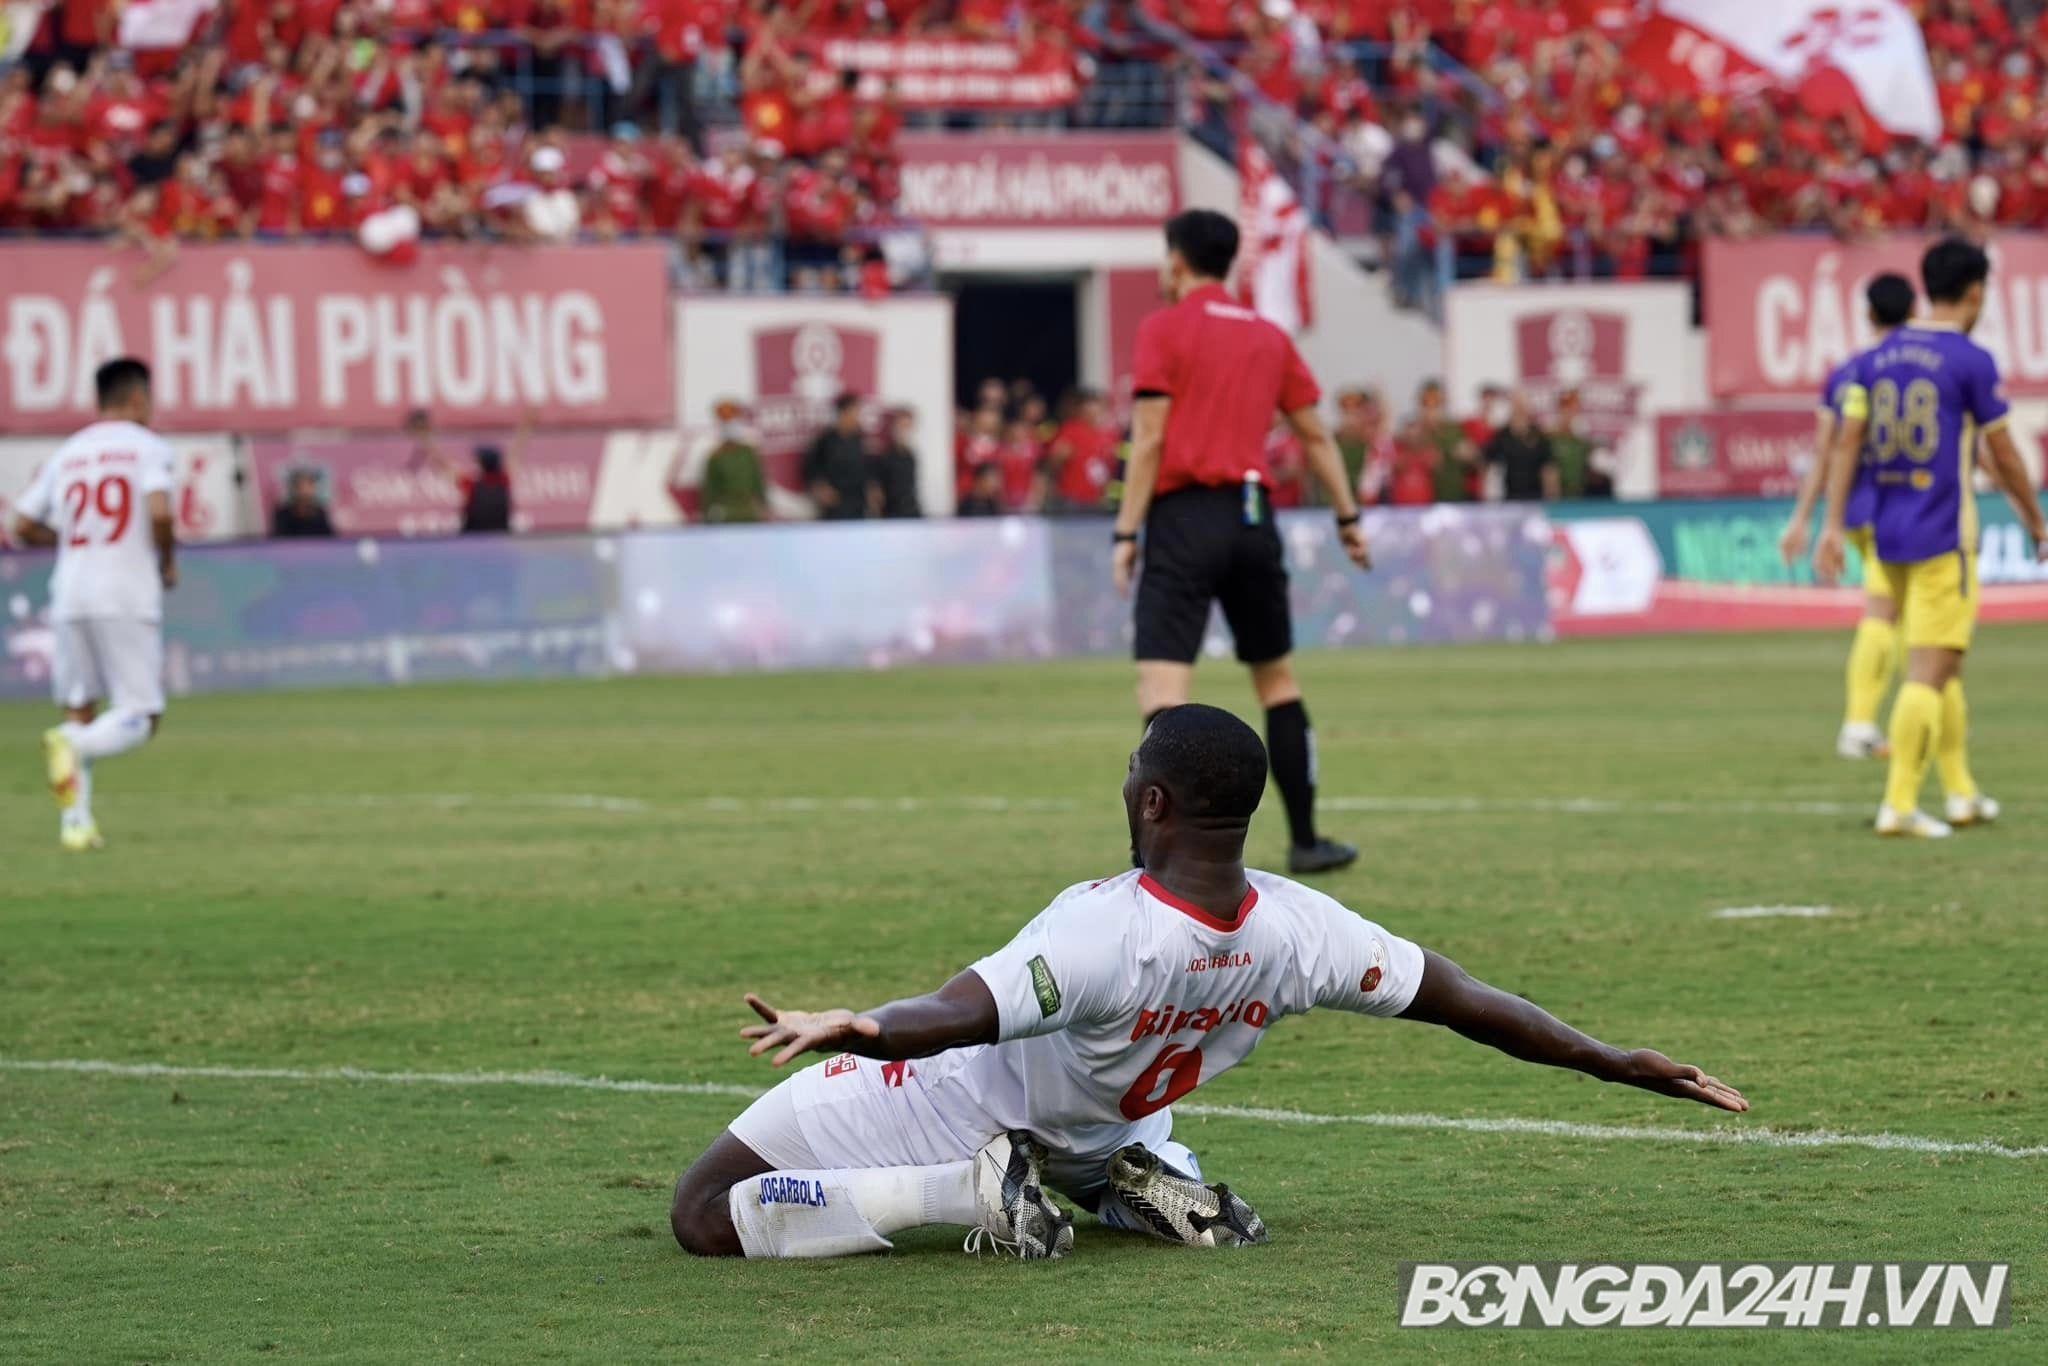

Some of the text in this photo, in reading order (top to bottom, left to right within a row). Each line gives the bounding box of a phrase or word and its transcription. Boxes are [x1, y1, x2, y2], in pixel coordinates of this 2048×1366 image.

[151, 259, 295, 407] HẢI
[317, 266, 607, 406] PHÒNG
[1871, 377, 1940, 463] 88
[64, 474, 132, 548] 29
[1119, 1043, 1203, 1122] 6
[759, 1177, 826, 1207] JOGARBOLA
